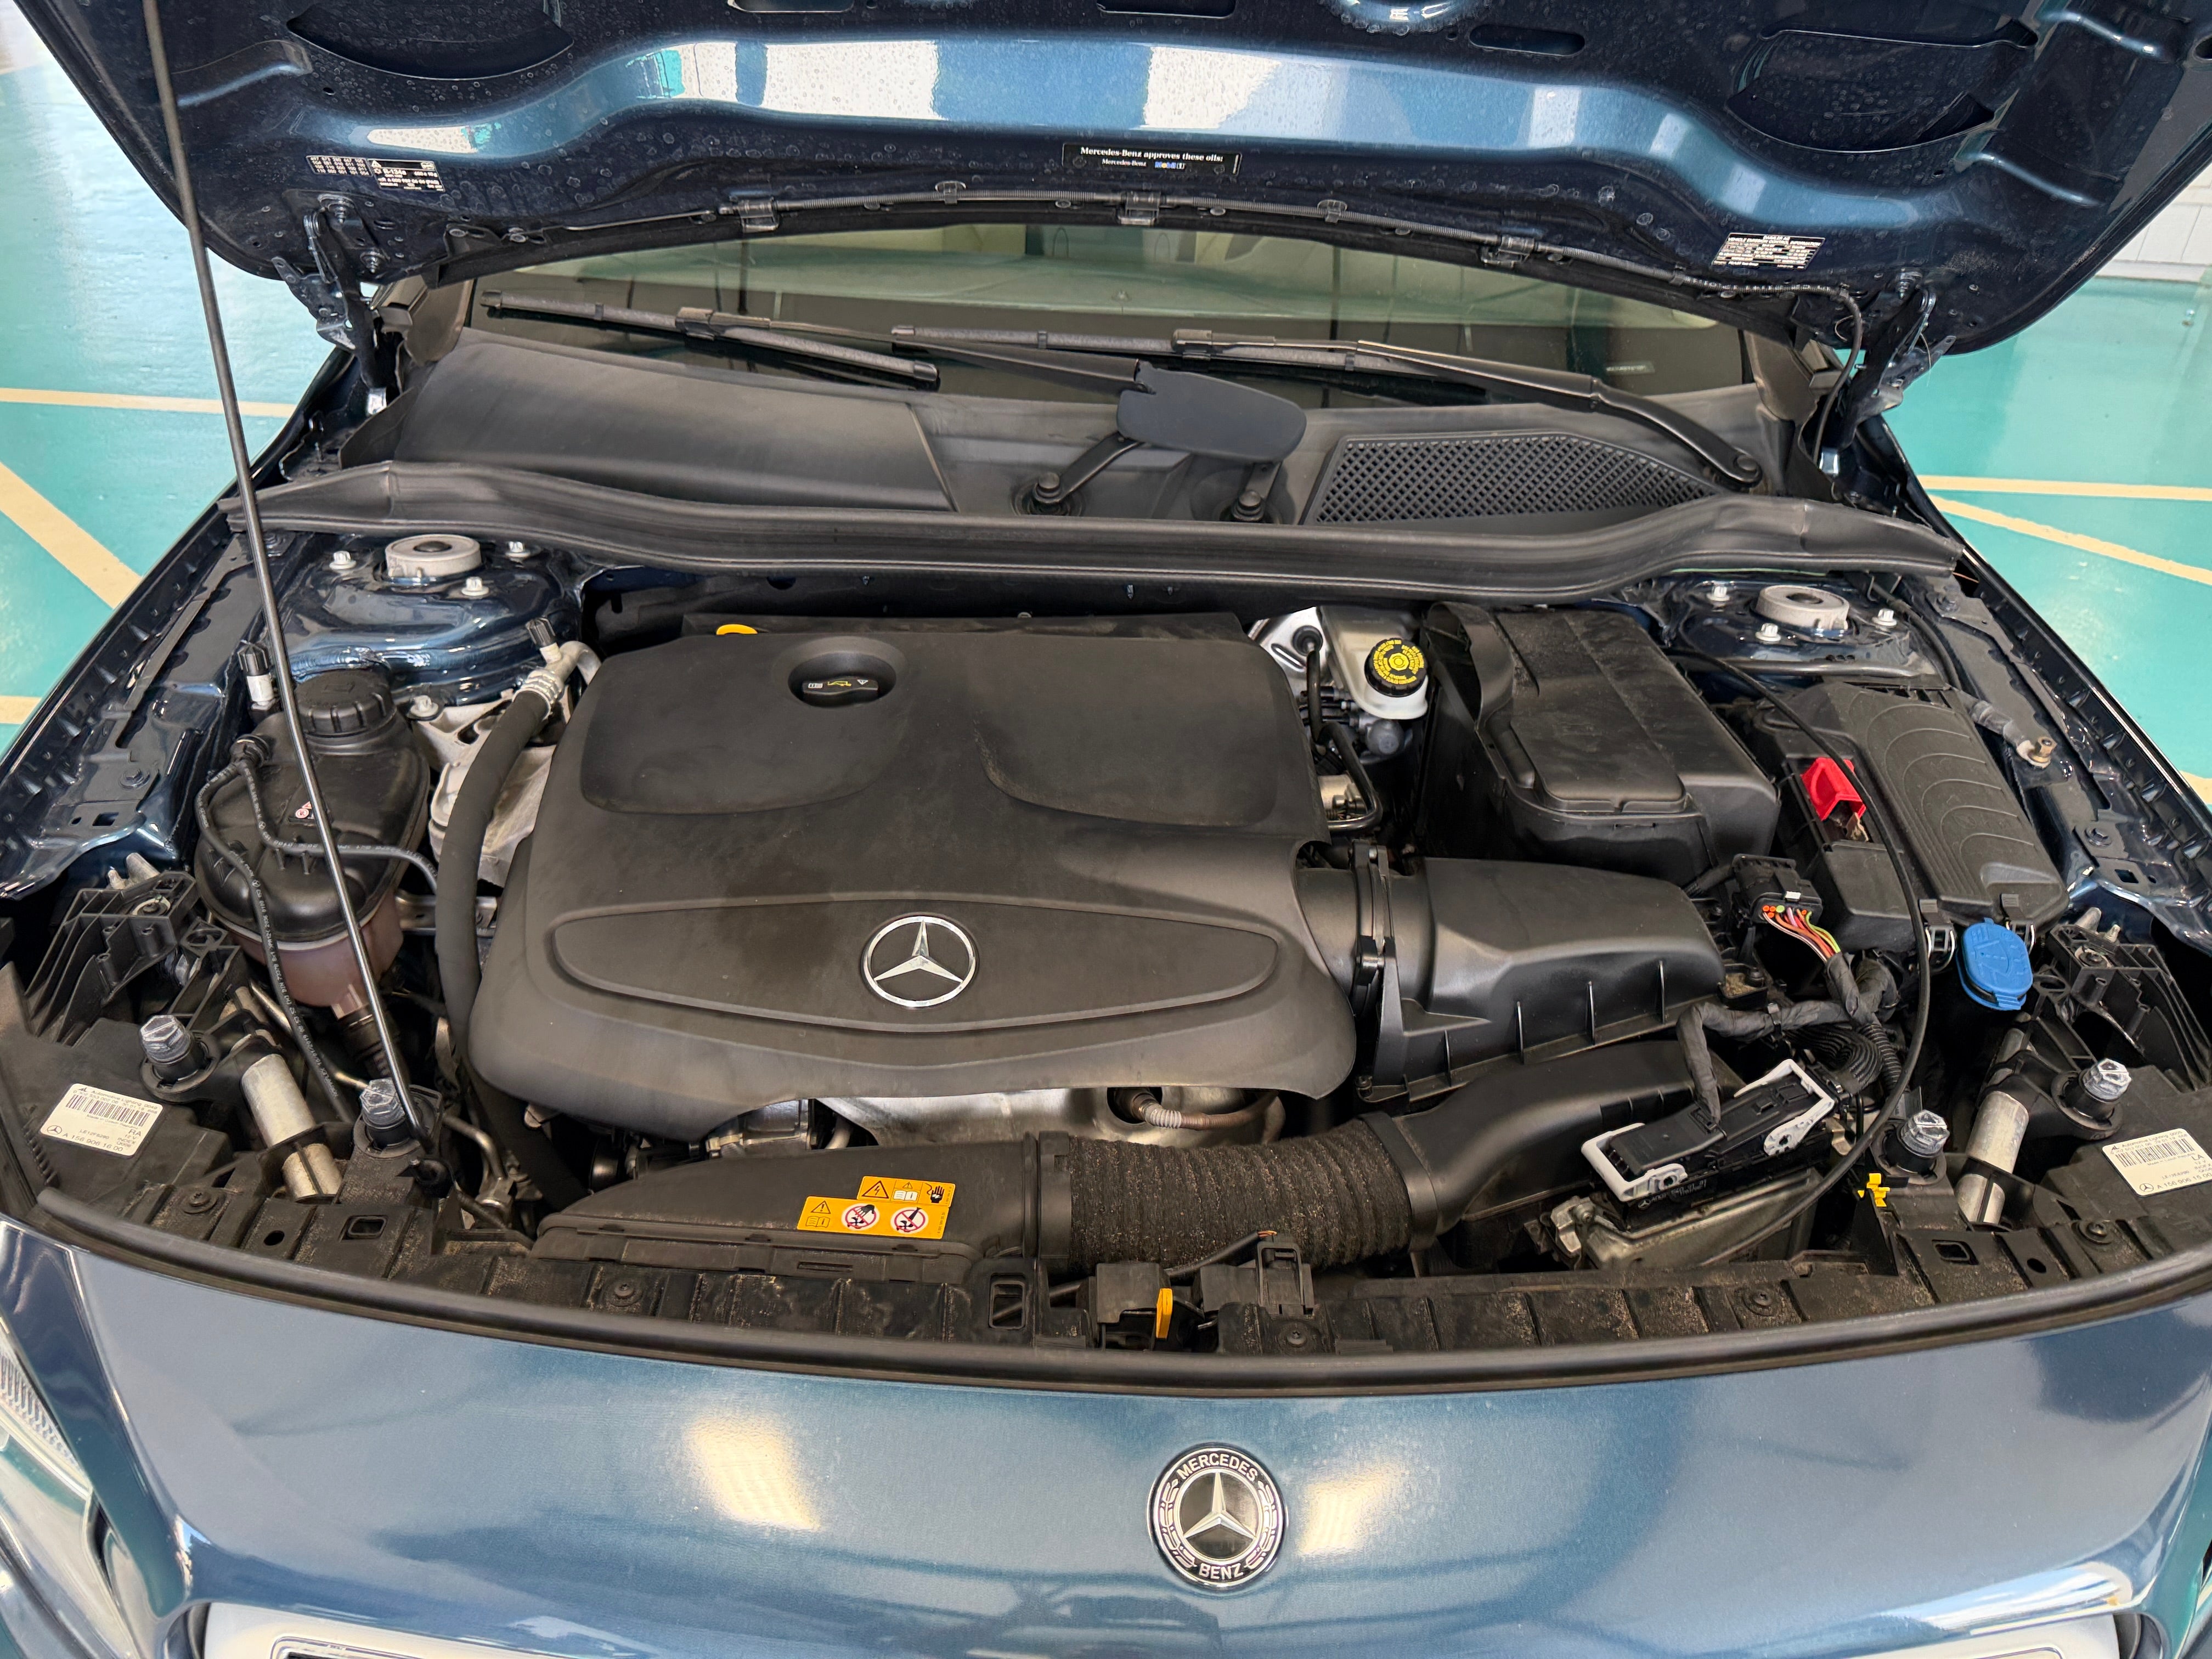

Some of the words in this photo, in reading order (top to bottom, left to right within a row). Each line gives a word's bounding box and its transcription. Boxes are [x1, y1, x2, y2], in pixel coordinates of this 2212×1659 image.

[1080, 146, 1142, 157] Mercedes-Benz
[1182, 153, 1204, 161] these
[91, 1090, 121, 1099] Automotive
[1177, 1453, 1259, 1481] MERCEDES
[1199, 1562, 1244, 1580] BENZ
